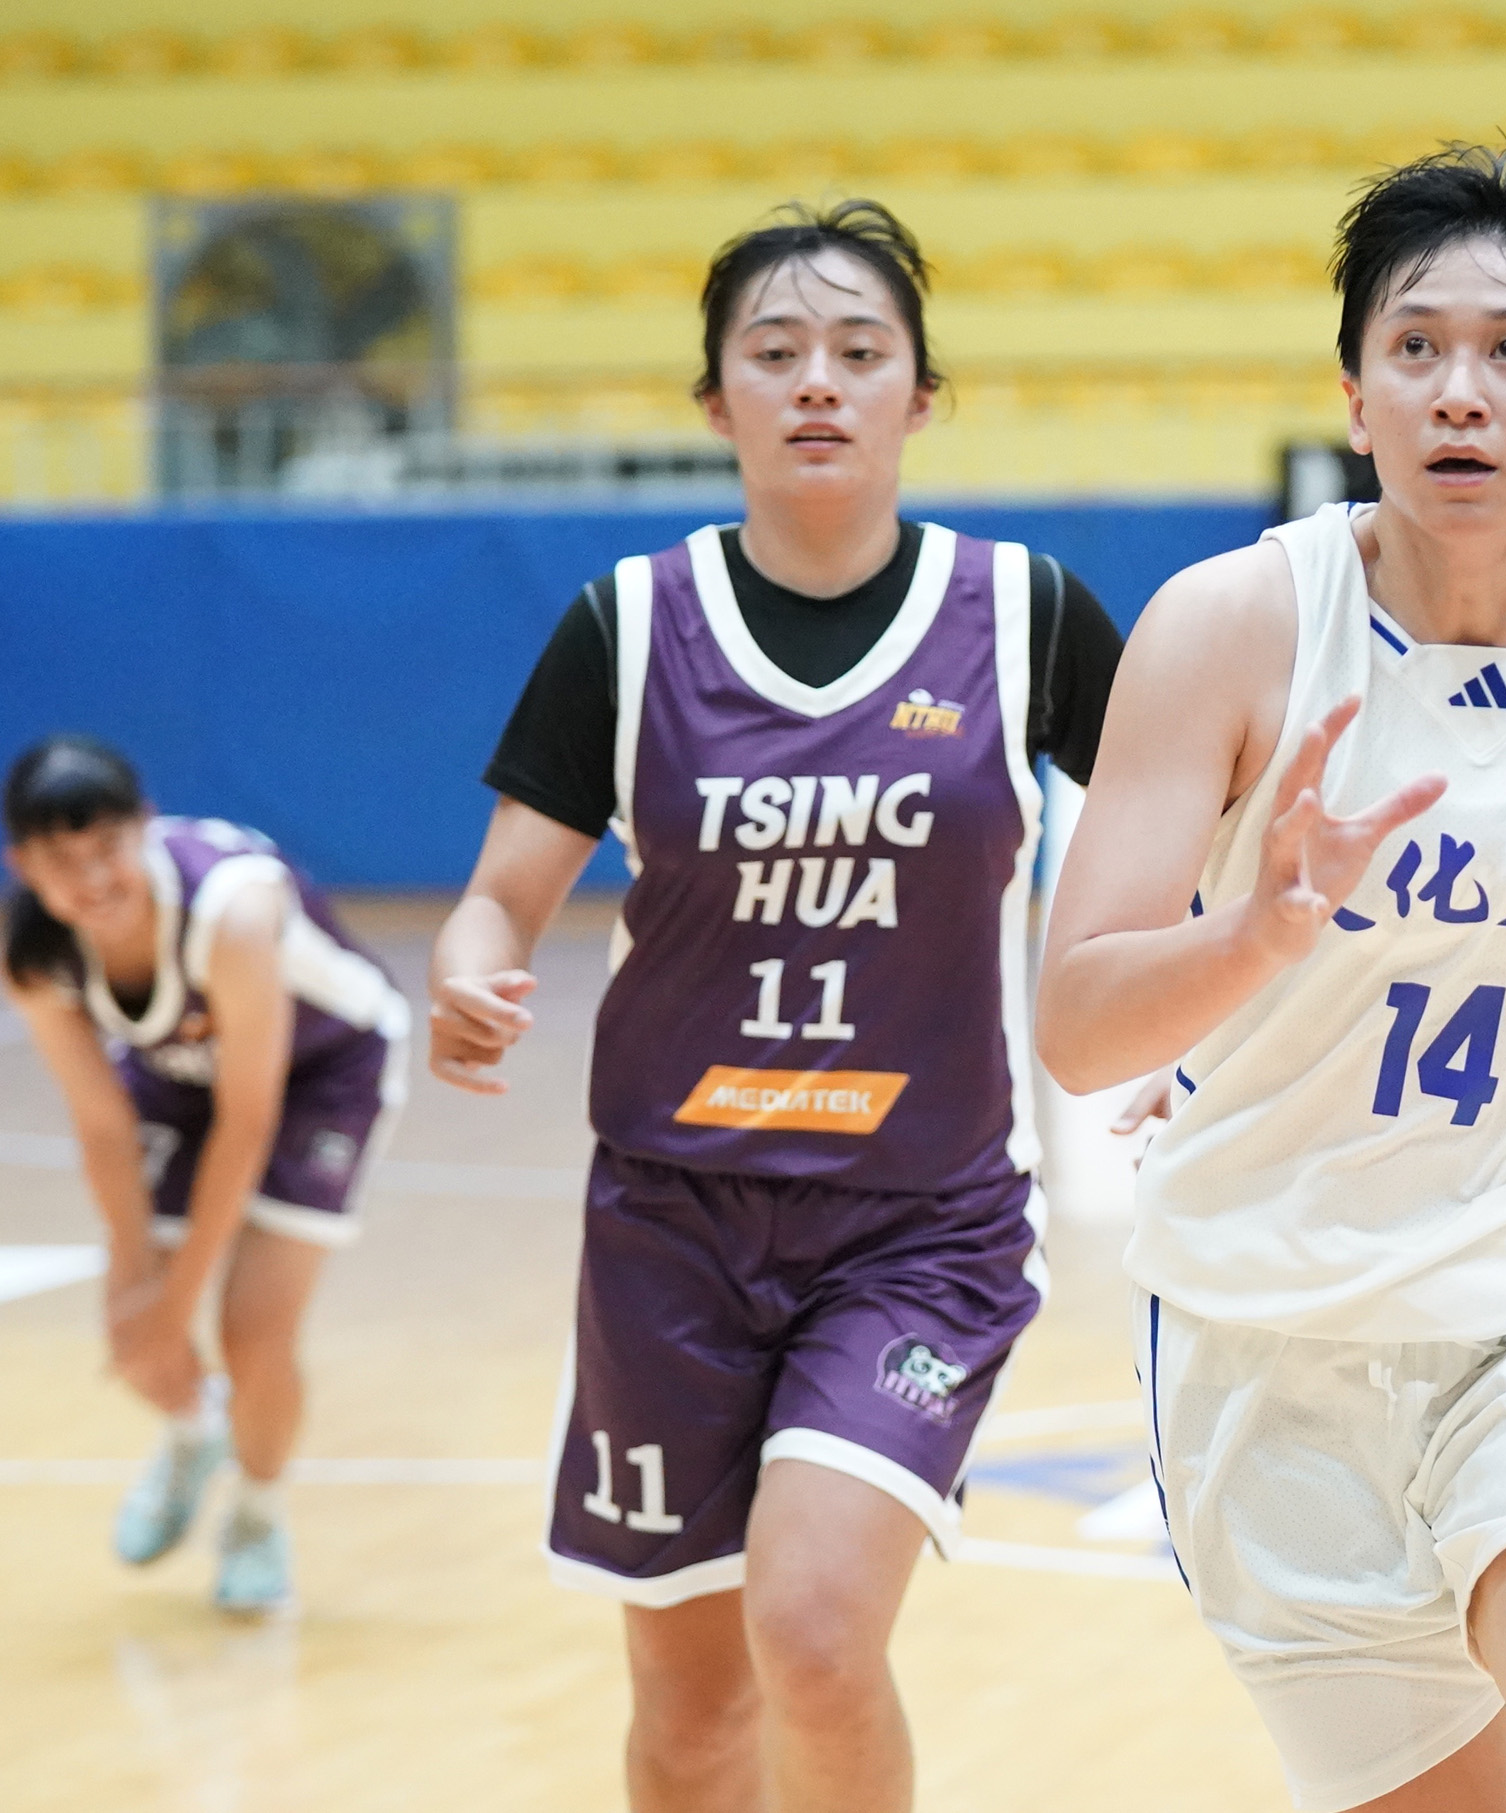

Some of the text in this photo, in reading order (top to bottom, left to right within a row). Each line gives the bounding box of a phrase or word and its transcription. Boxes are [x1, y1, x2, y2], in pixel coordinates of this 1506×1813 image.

[695, 772, 935, 852] TSING
[732, 857, 899, 929] HUA
[740, 957, 856, 1041] 11
[1371, 981, 1506, 1127] 14
[706, 1085, 873, 1115] MEDIATEK
[583, 1430, 684, 1534] 11
